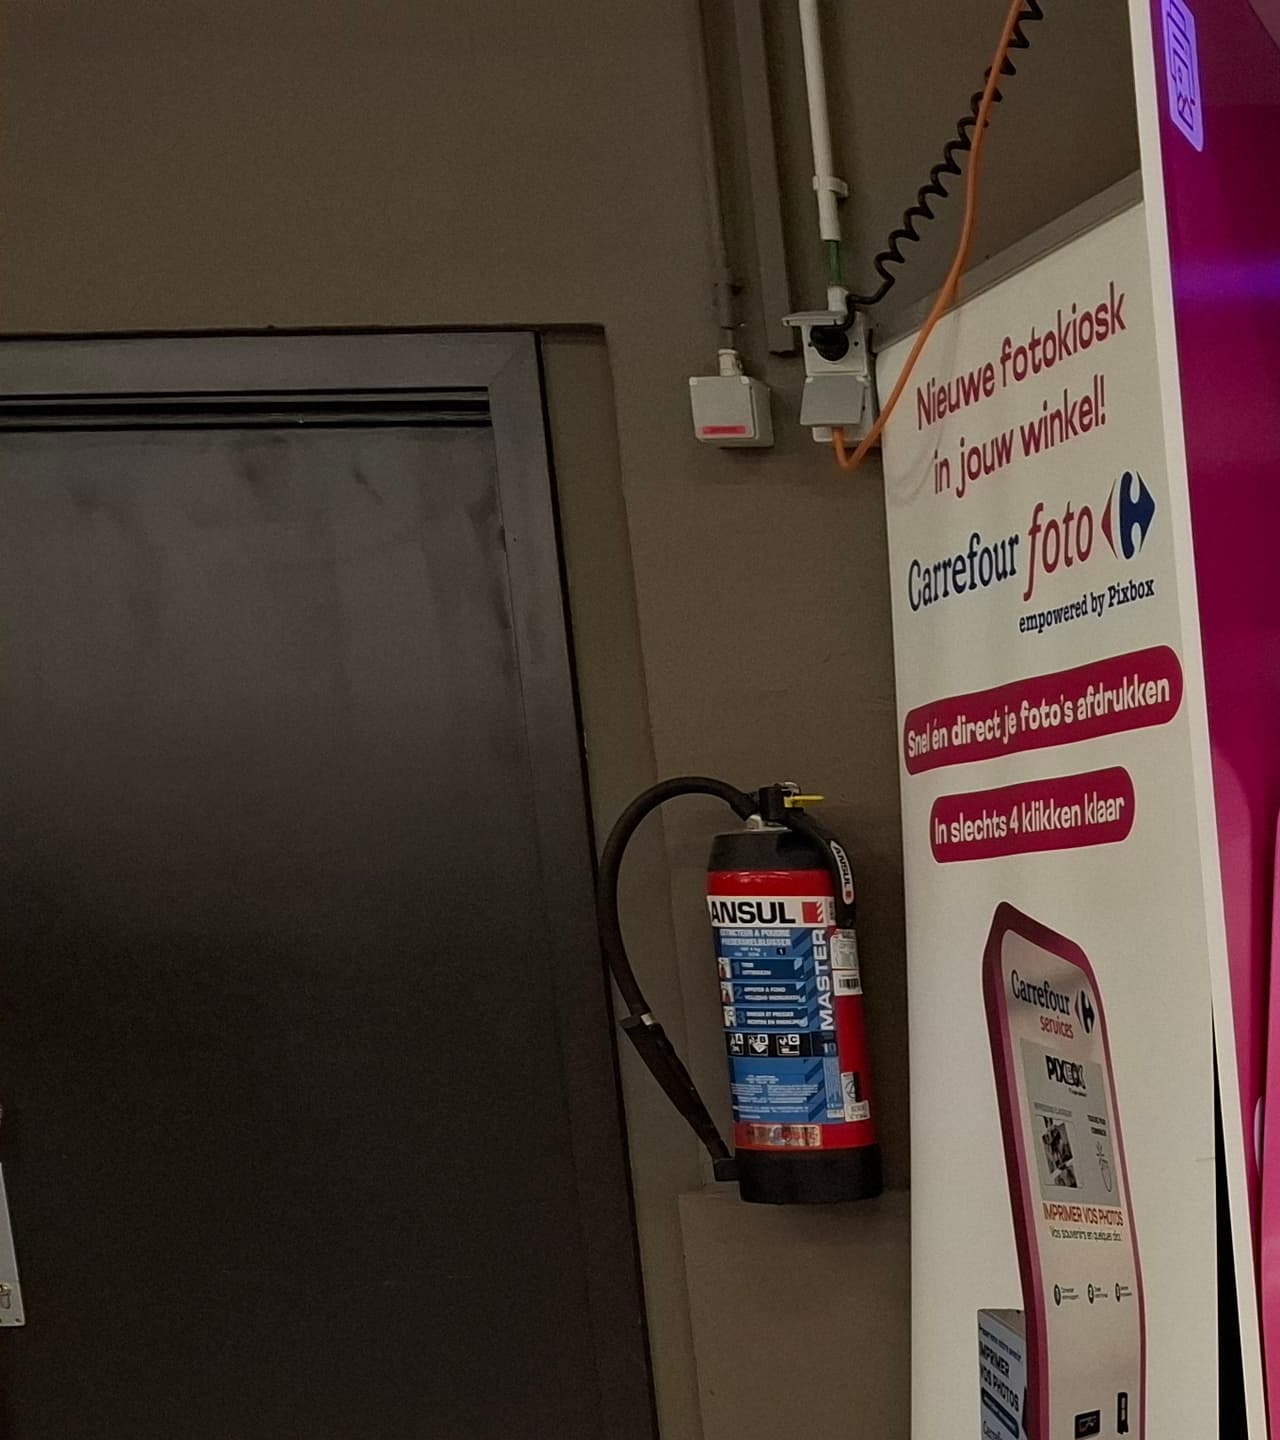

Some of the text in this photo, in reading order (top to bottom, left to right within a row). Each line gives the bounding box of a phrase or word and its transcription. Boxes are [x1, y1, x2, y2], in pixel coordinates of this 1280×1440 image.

[917, 281, 1127, 431] Nieuwe fotokiosk
[934, 375, 1106, 498] in jouw winkel!
[907, 501, 1094, 611] Carrefour foto
[1018, 578, 1155, 634] empowered by Pixbox
[907, 673, 1170, 758] Snel én direct je foto's afdrukken
[935, 793, 1125, 844] In slechts 4 klikken klaar
[711, 901, 796, 924] ANSUL
[812, 929, 834, 1030] MASTER
[1011, 969, 1070, 1016] Carrefour
